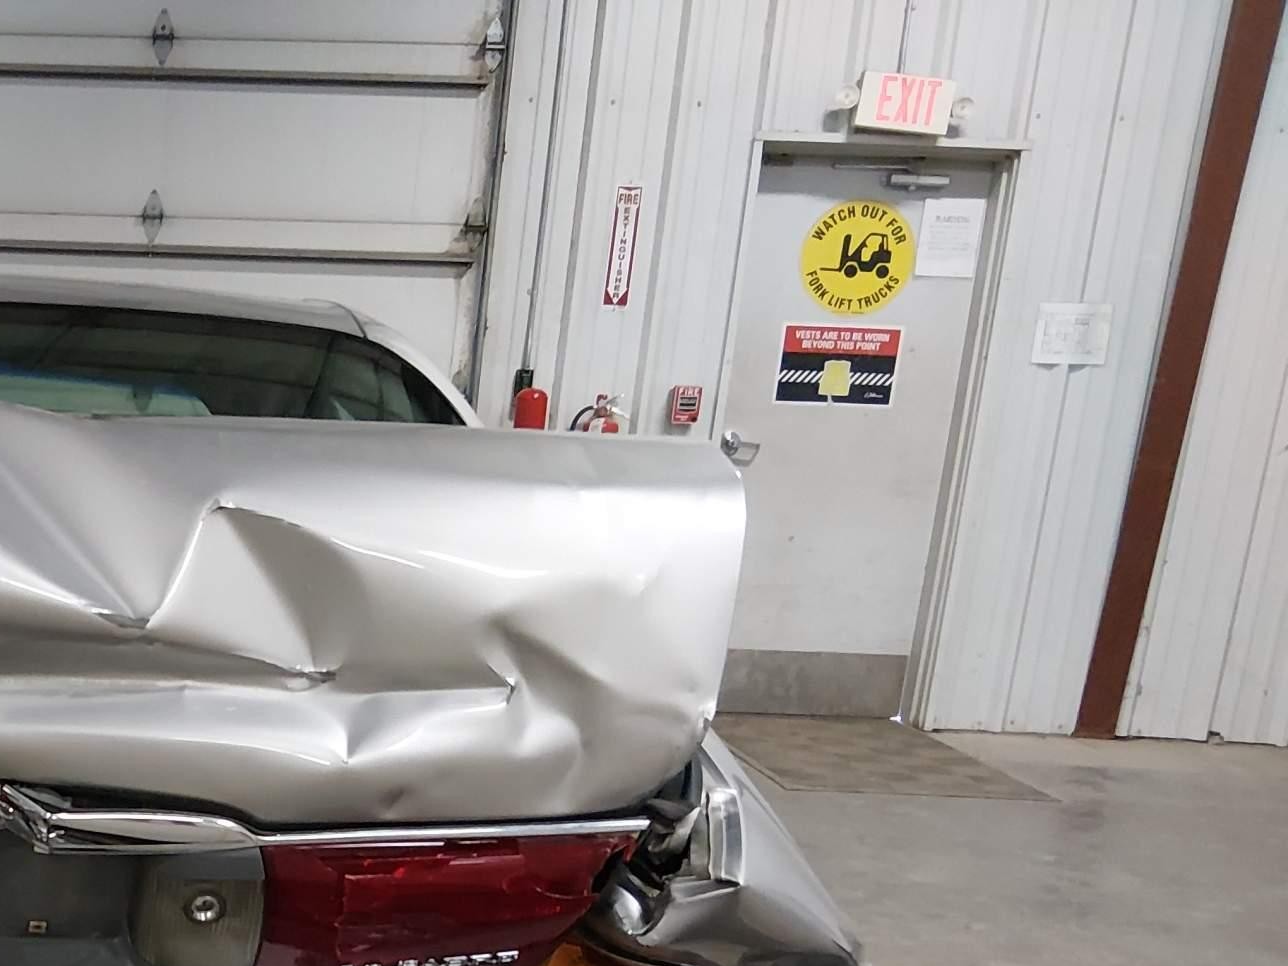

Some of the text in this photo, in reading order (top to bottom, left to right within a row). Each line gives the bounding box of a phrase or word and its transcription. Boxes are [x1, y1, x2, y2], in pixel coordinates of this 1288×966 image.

[875, 75, 943, 126] EXIT
[618, 193, 639, 205] FIRE
[812, 205, 856, 241] WATCH
[861, 204, 888, 222] OUT
[886, 218, 907, 245] FOR
[612, 207, 631, 299] EXTINGUISHER
[806, 270, 900, 310] FORK LIFT TRUCKS
[795, 330, 890, 343] VESTS ARE TO BE WORN
[801, 340, 881, 351] BEYOND THIS POINT
